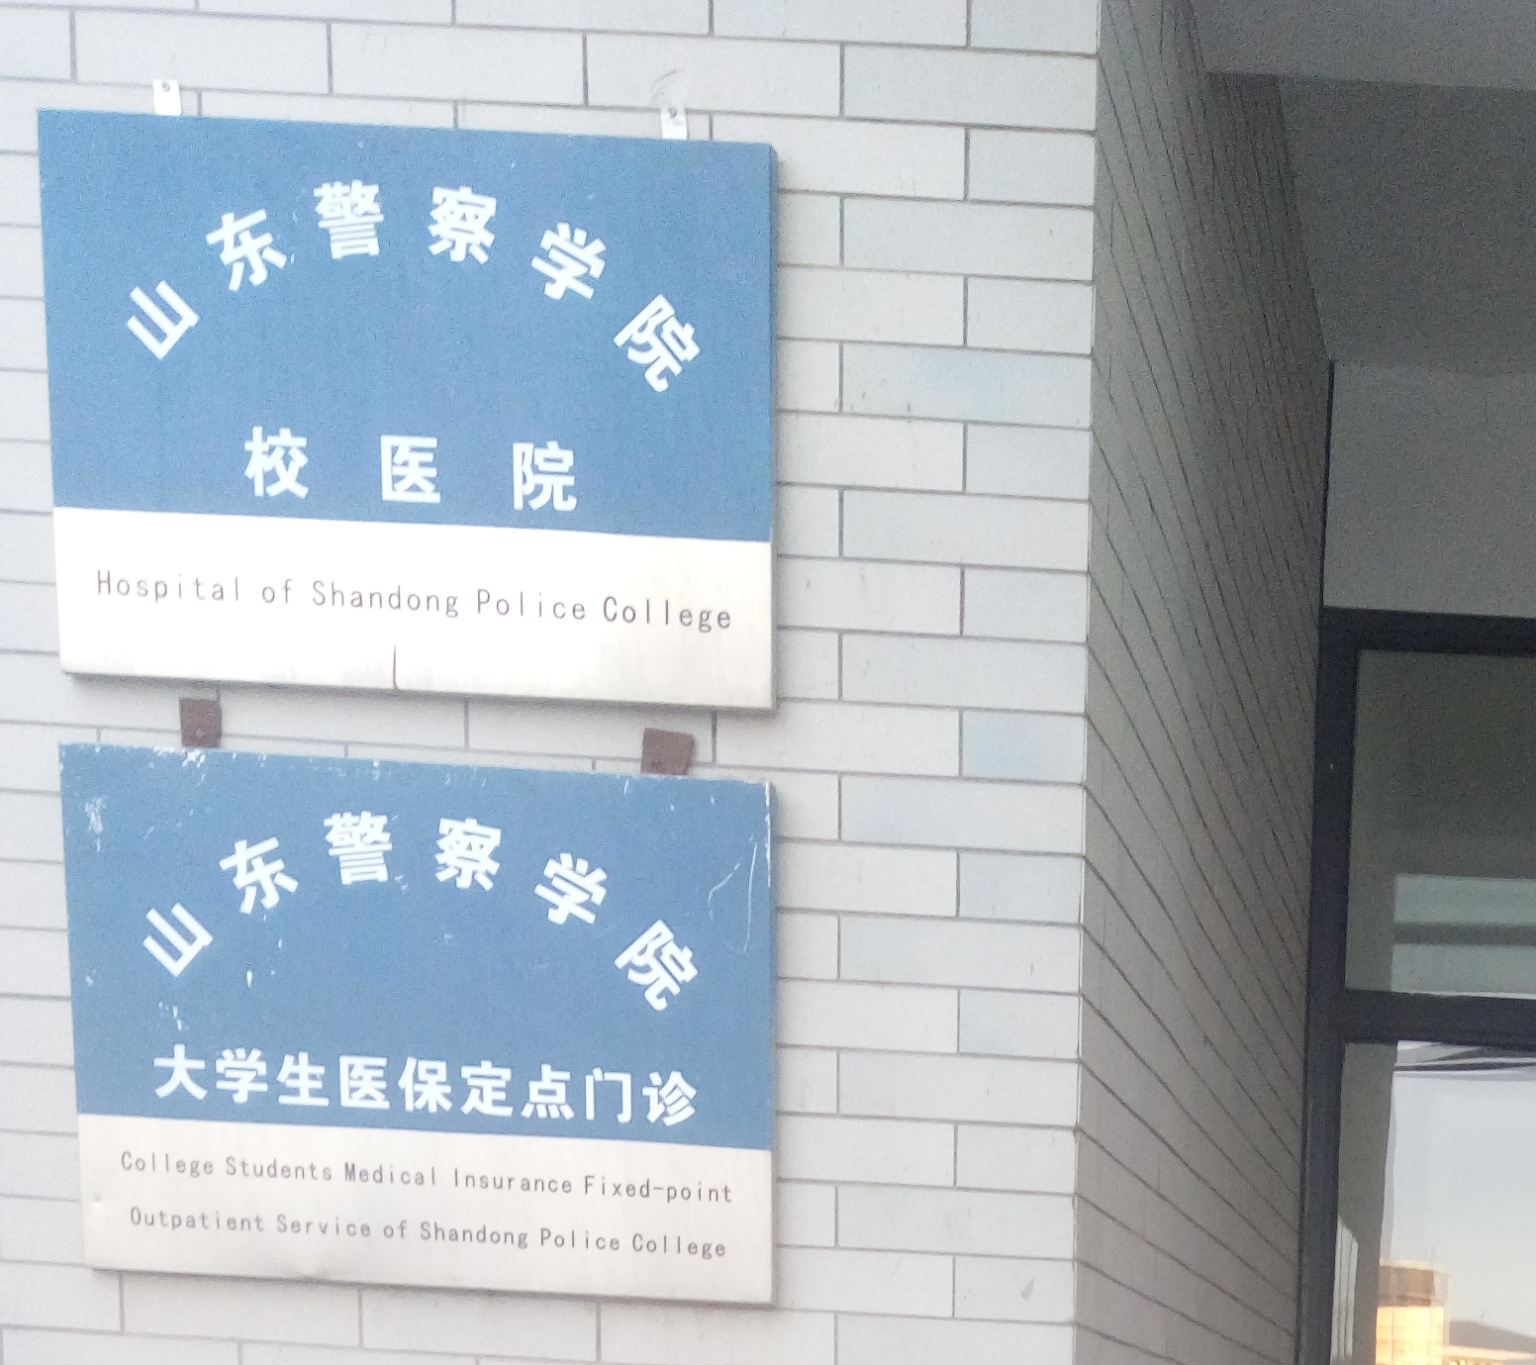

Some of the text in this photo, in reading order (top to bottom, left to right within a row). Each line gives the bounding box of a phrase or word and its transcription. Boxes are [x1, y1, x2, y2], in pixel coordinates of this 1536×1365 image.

[127, 179, 701, 392] 山东警察学院
[244, 426, 577, 511] 校医院
[97, 569, 731, 633] Hospital of Shandong Police College
[141, 810, 699, 1012] 山东警察学院
[152, 1043, 697, 1128] 大学生医保定点门诊
[121, 1150, 732, 1204] College Students Medical Insurance Fixed-point
[130, 1206, 726, 1260] Outpatient Service of Shandong Police College
